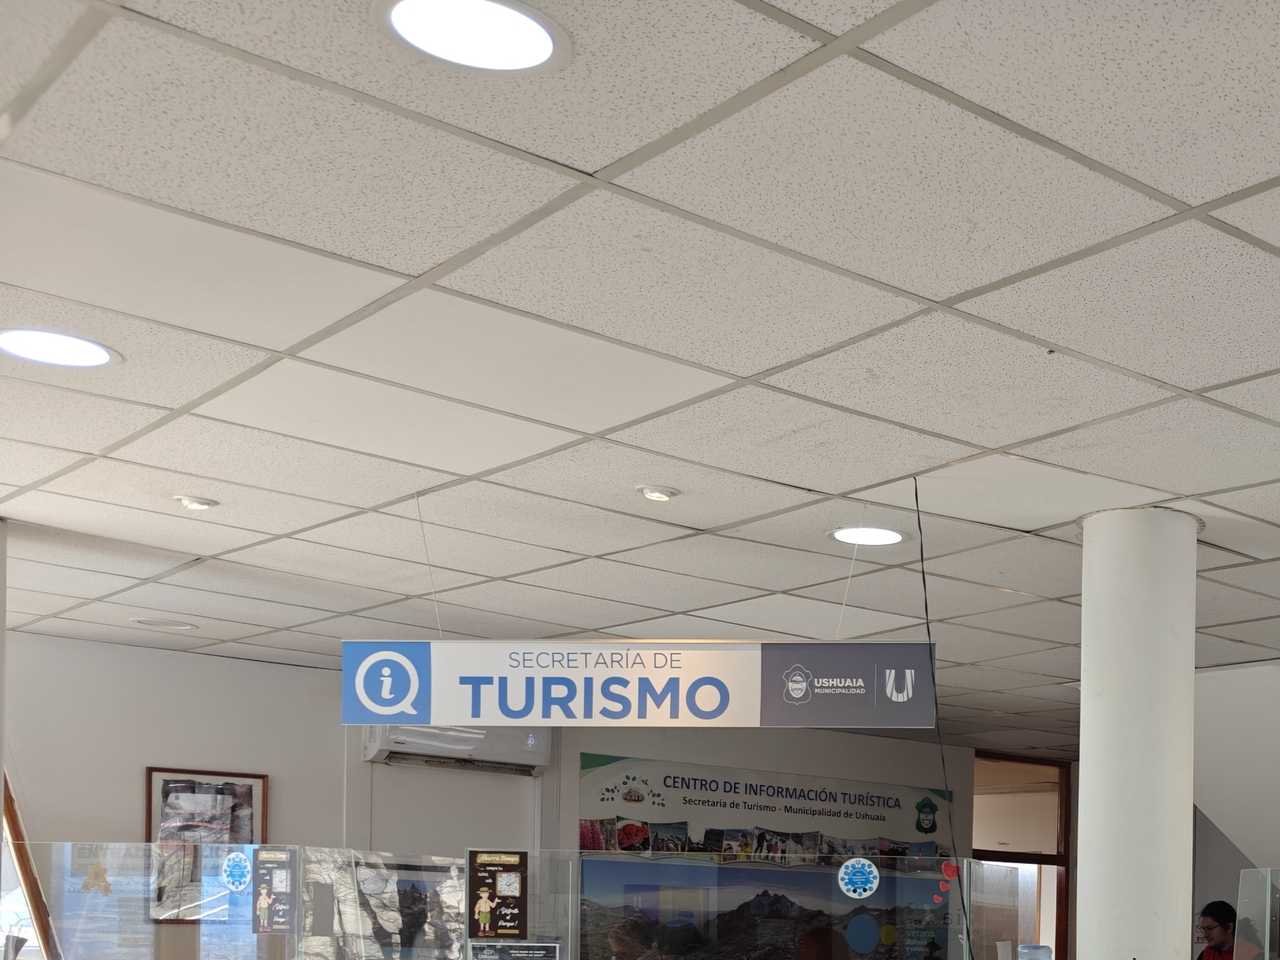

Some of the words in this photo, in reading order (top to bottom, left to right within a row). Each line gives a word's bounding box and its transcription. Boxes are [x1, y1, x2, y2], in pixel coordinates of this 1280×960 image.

[508, 648, 646, 670] SECRETARÍA
[654, 652, 682, 669] DE
[814, 678, 865, 688] USHUAIA
[458, 676, 730, 720] TURISMO
[663, 774, 720, 793] CENTRO
[723, 780, 741, 794] DE
[744, 782, 838, 804] INFORMACIÓN
[841, 790, 902, 810] TURÍSTICA
[682, 796, 728, 808] Secretaría
[730, 800, 740, 810] de
[742, 801, 776, 813] Turismo
[784, 804, 841, 819] Municipalidad
[843, 810, 854, 819] de
[855, 810, 886, 822] Ushuaia
